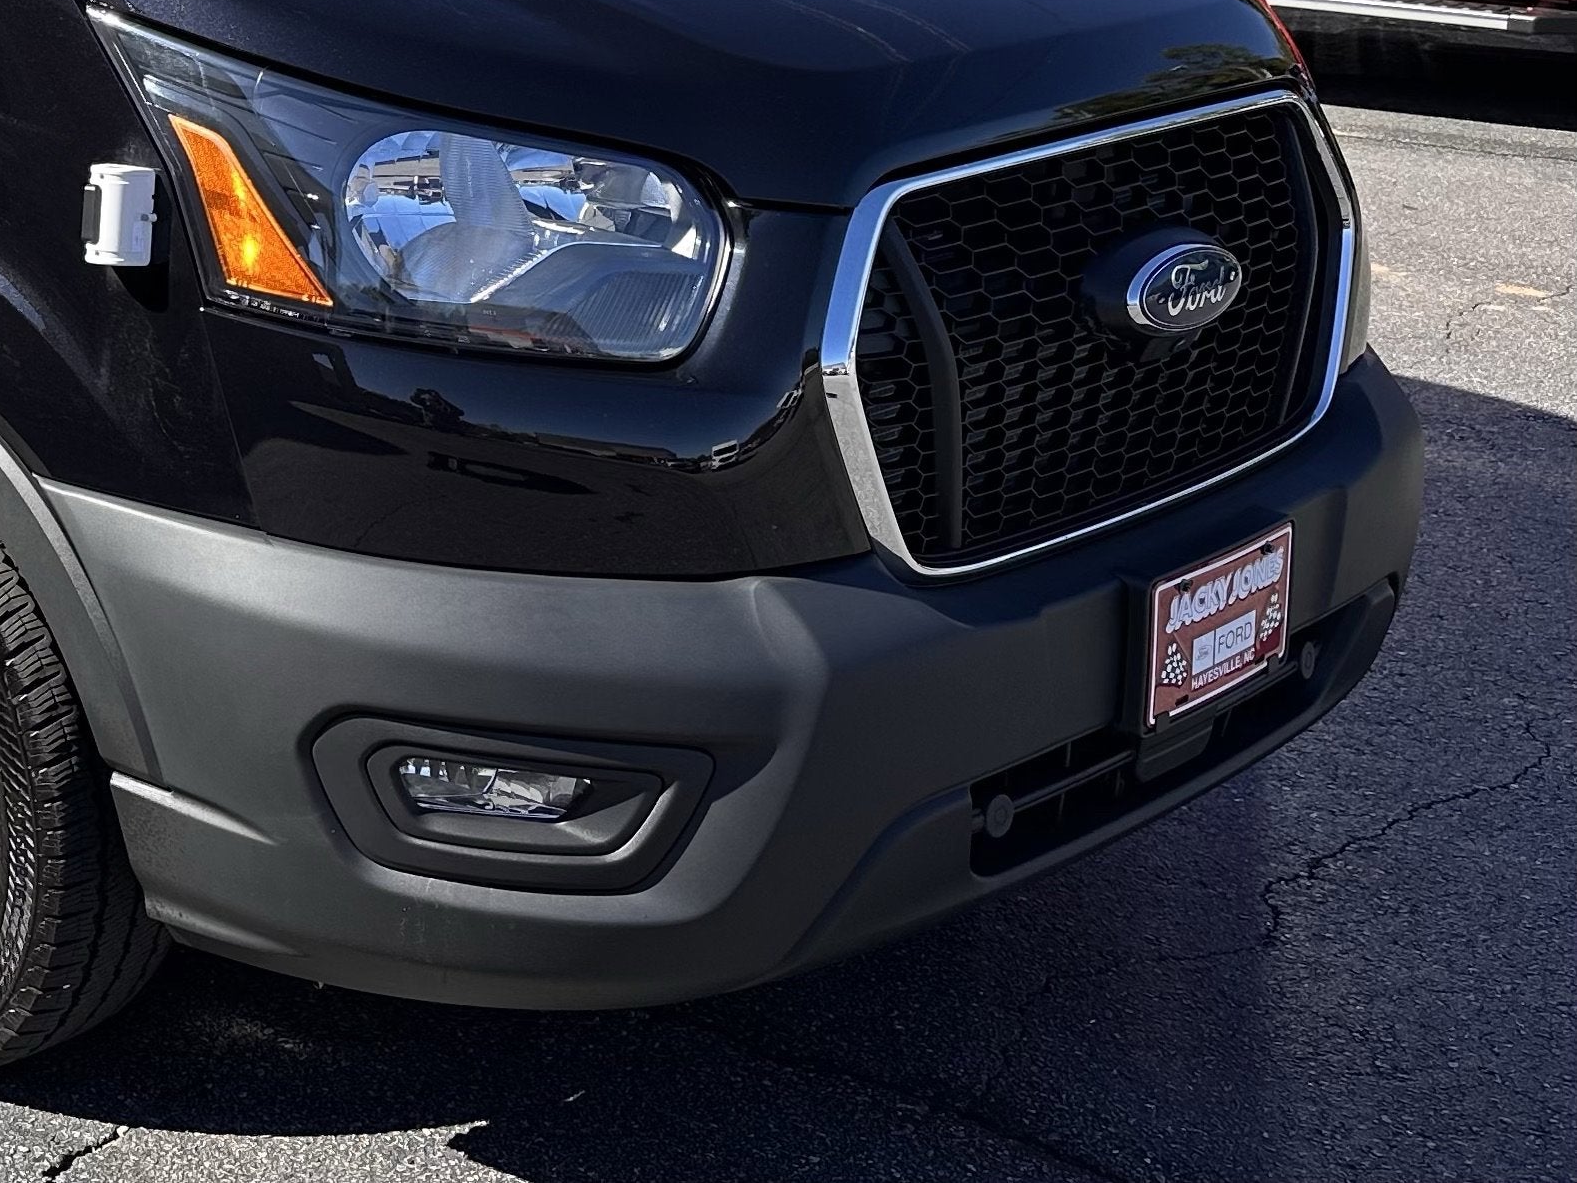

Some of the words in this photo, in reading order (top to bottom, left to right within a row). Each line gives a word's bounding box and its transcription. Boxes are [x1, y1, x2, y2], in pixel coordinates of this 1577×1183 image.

[1168, 260, 1227, 316] Ford
[1166, 573, 1232, 633] JACKY
[1228, 546, 1285, 605] JONES
[1217, 621, 1253, 654] FORD
[1243, 648, 1255, 666] NC
